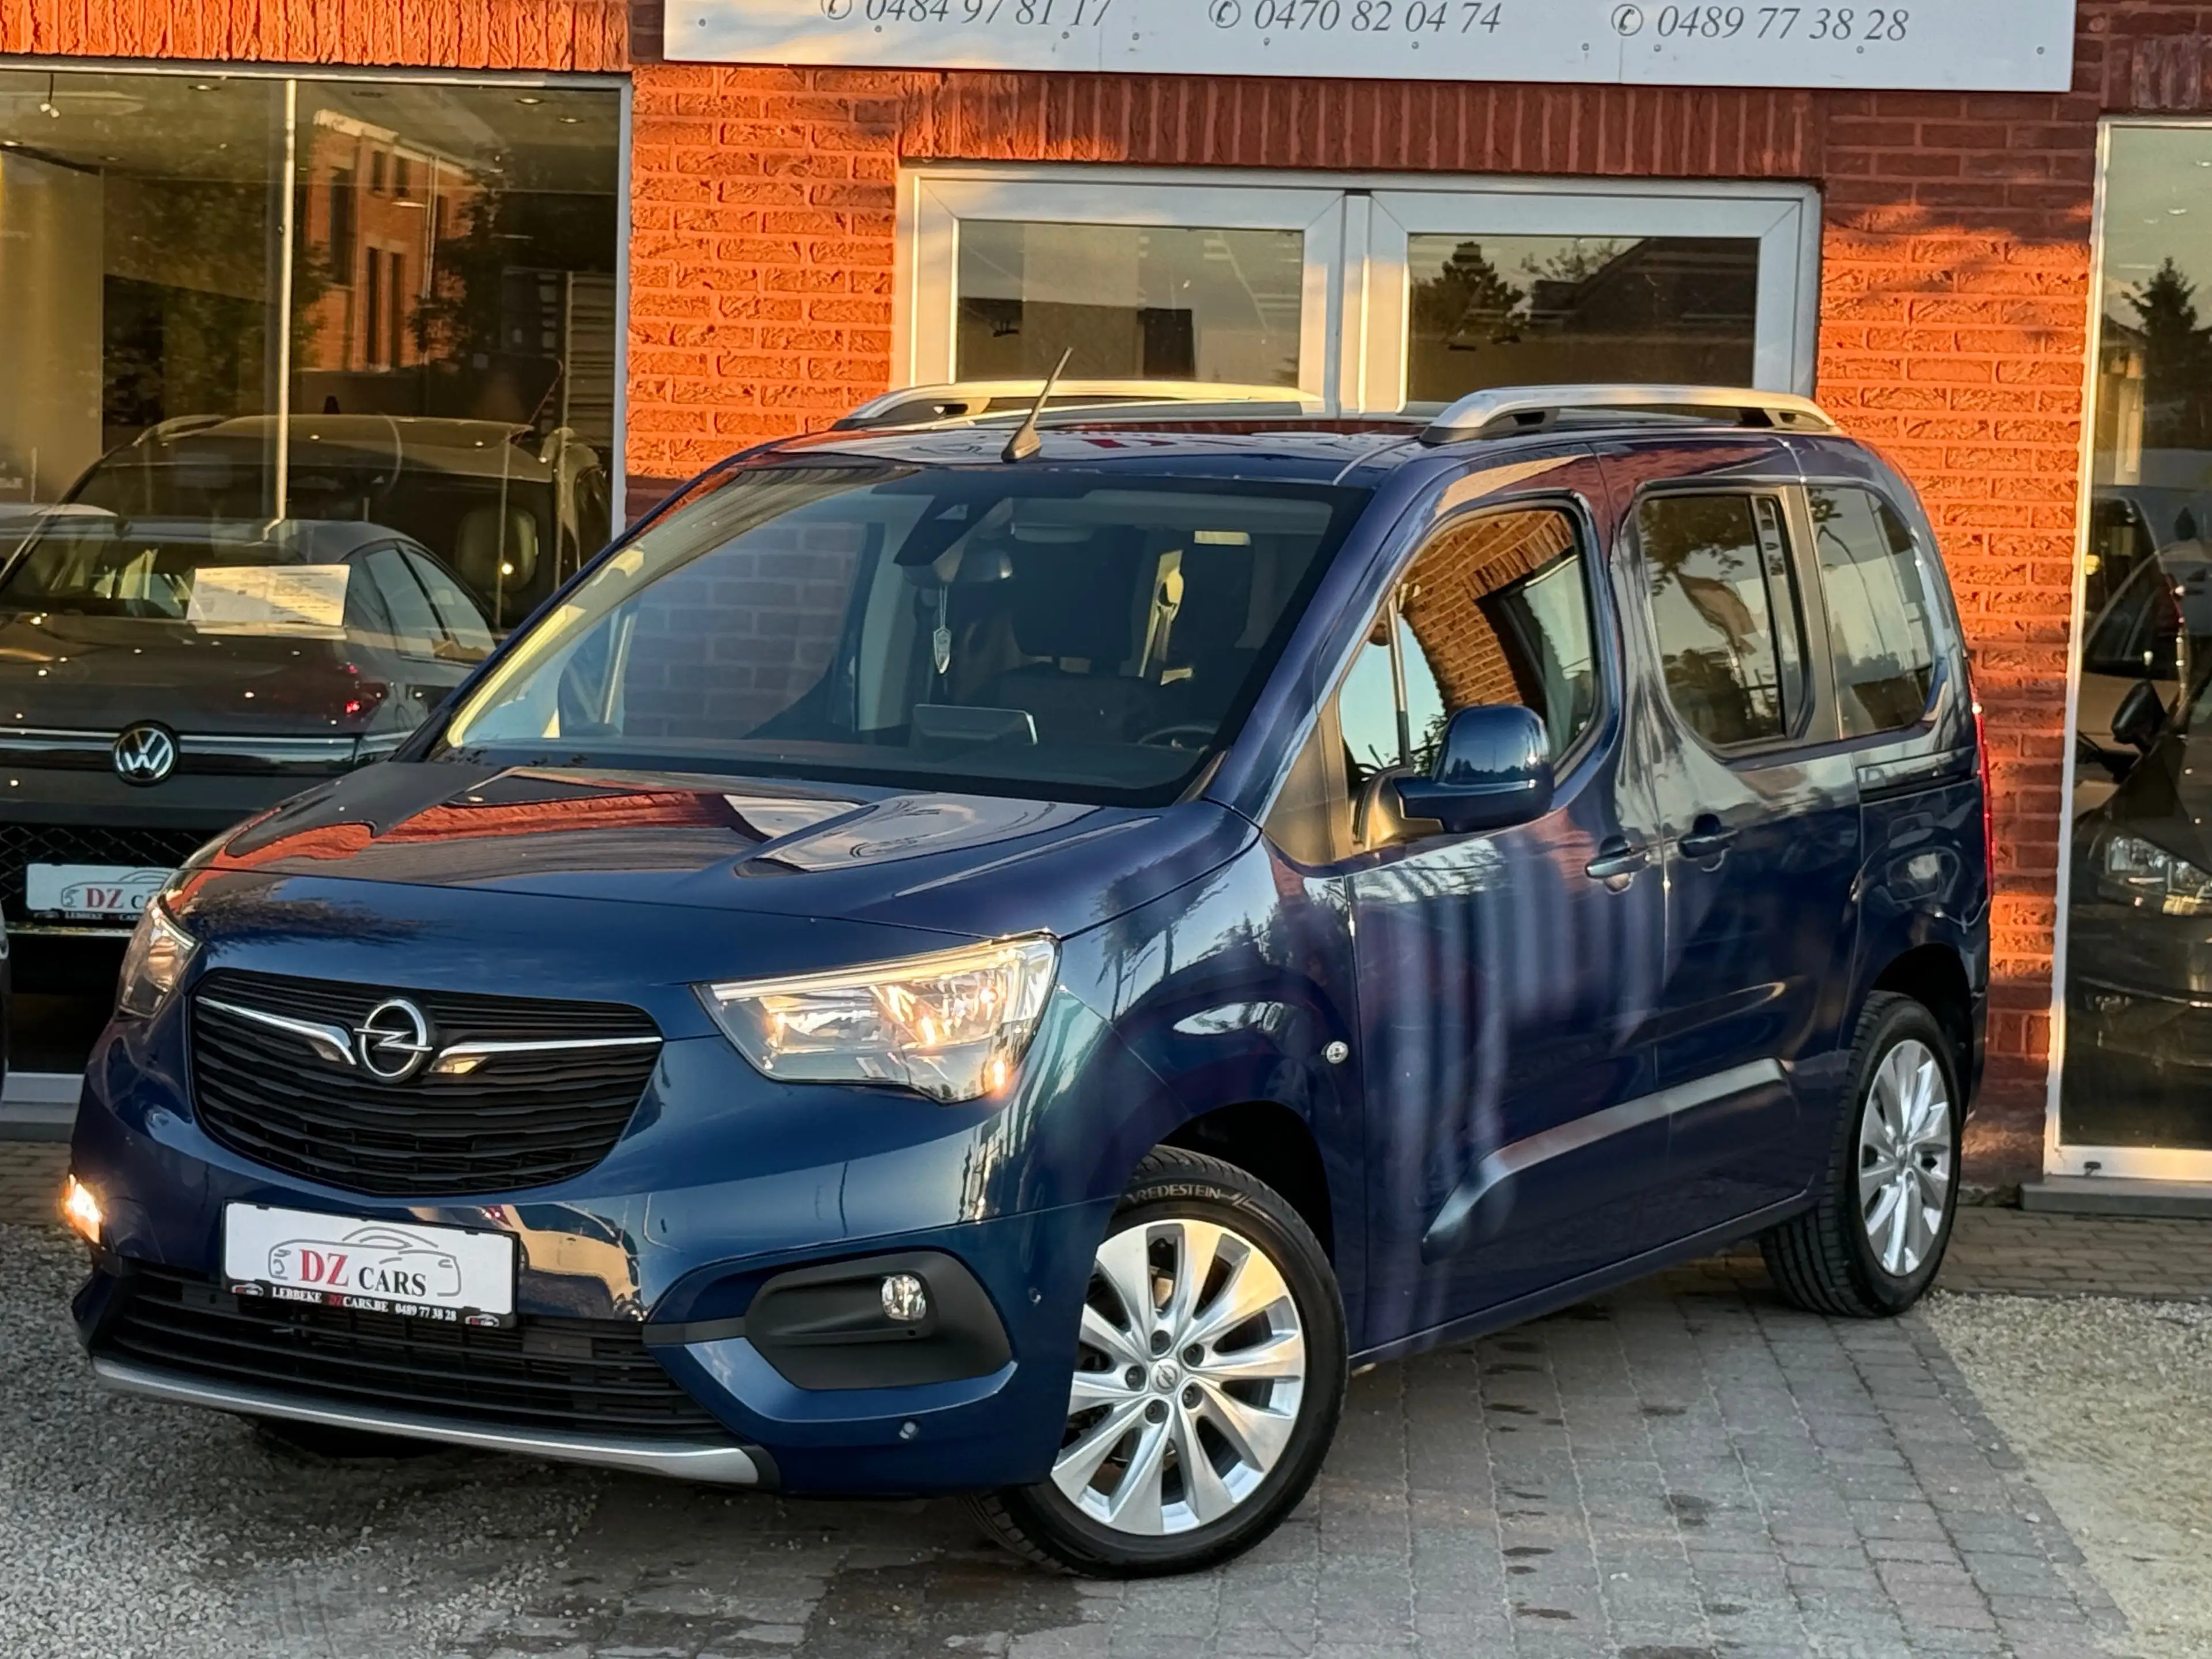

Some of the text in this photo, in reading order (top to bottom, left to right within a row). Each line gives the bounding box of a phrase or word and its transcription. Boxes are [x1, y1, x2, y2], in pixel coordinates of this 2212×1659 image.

[866, 0, 1112, 26] 0484 97 81 17
[1255, 0, 1502, 33] 0470 82 04 74
[1657, 5, 1909, 41] 0489 77 38 28
[85, 887, 124, 908] DZ
[1126, 1184, 1221, 1203] VREDESTEIN
[298, 1249, 426, 1297] DZ CARS
